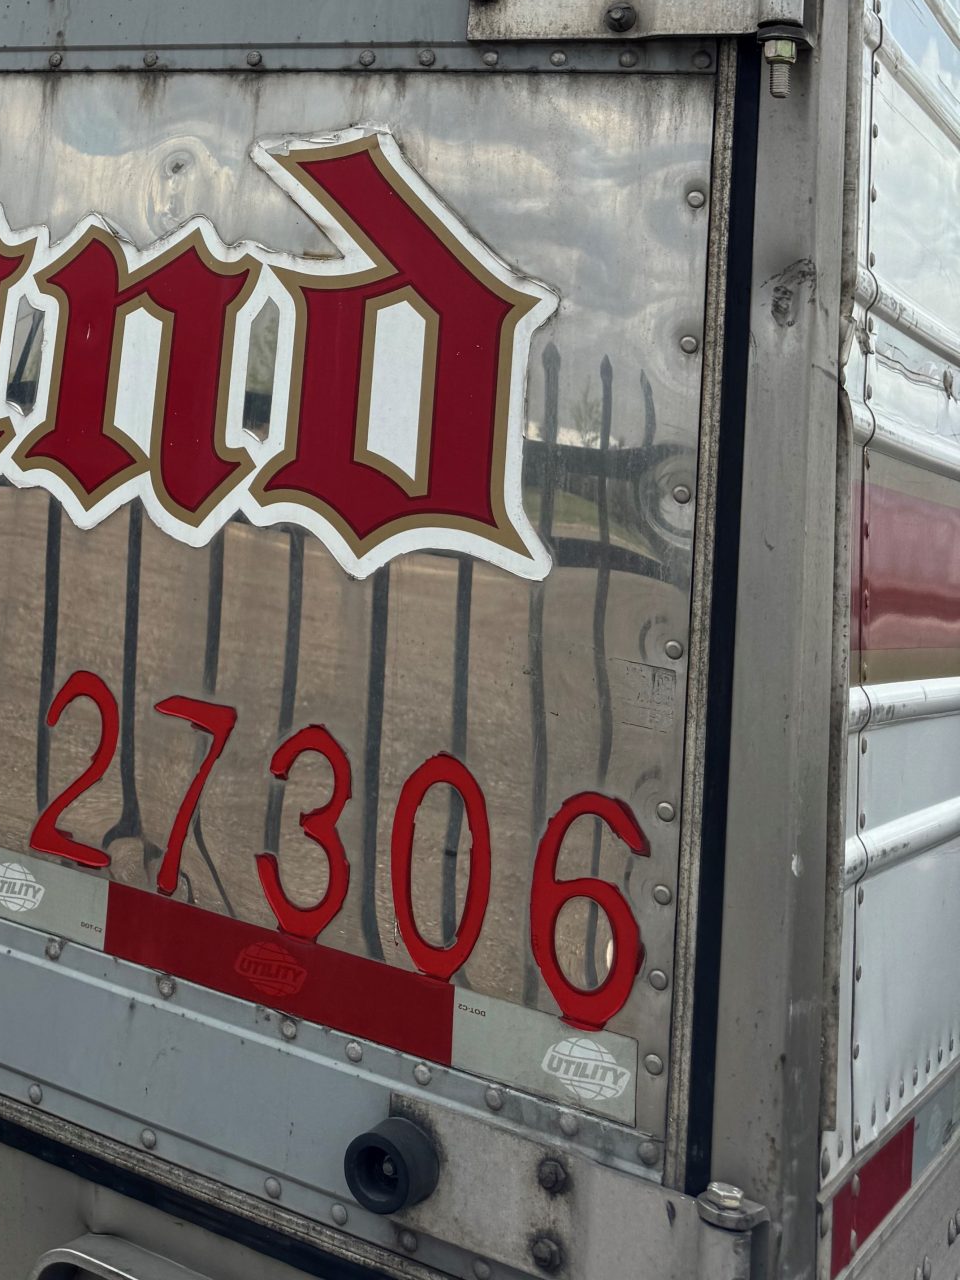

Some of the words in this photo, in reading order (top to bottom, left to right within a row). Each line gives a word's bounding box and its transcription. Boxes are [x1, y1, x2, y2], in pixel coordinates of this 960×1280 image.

[29, 670, 651, 1031] 27306
[242, 957, 302, 981] UTILITY
[546, 1054, 627, 1086] UTILITY
